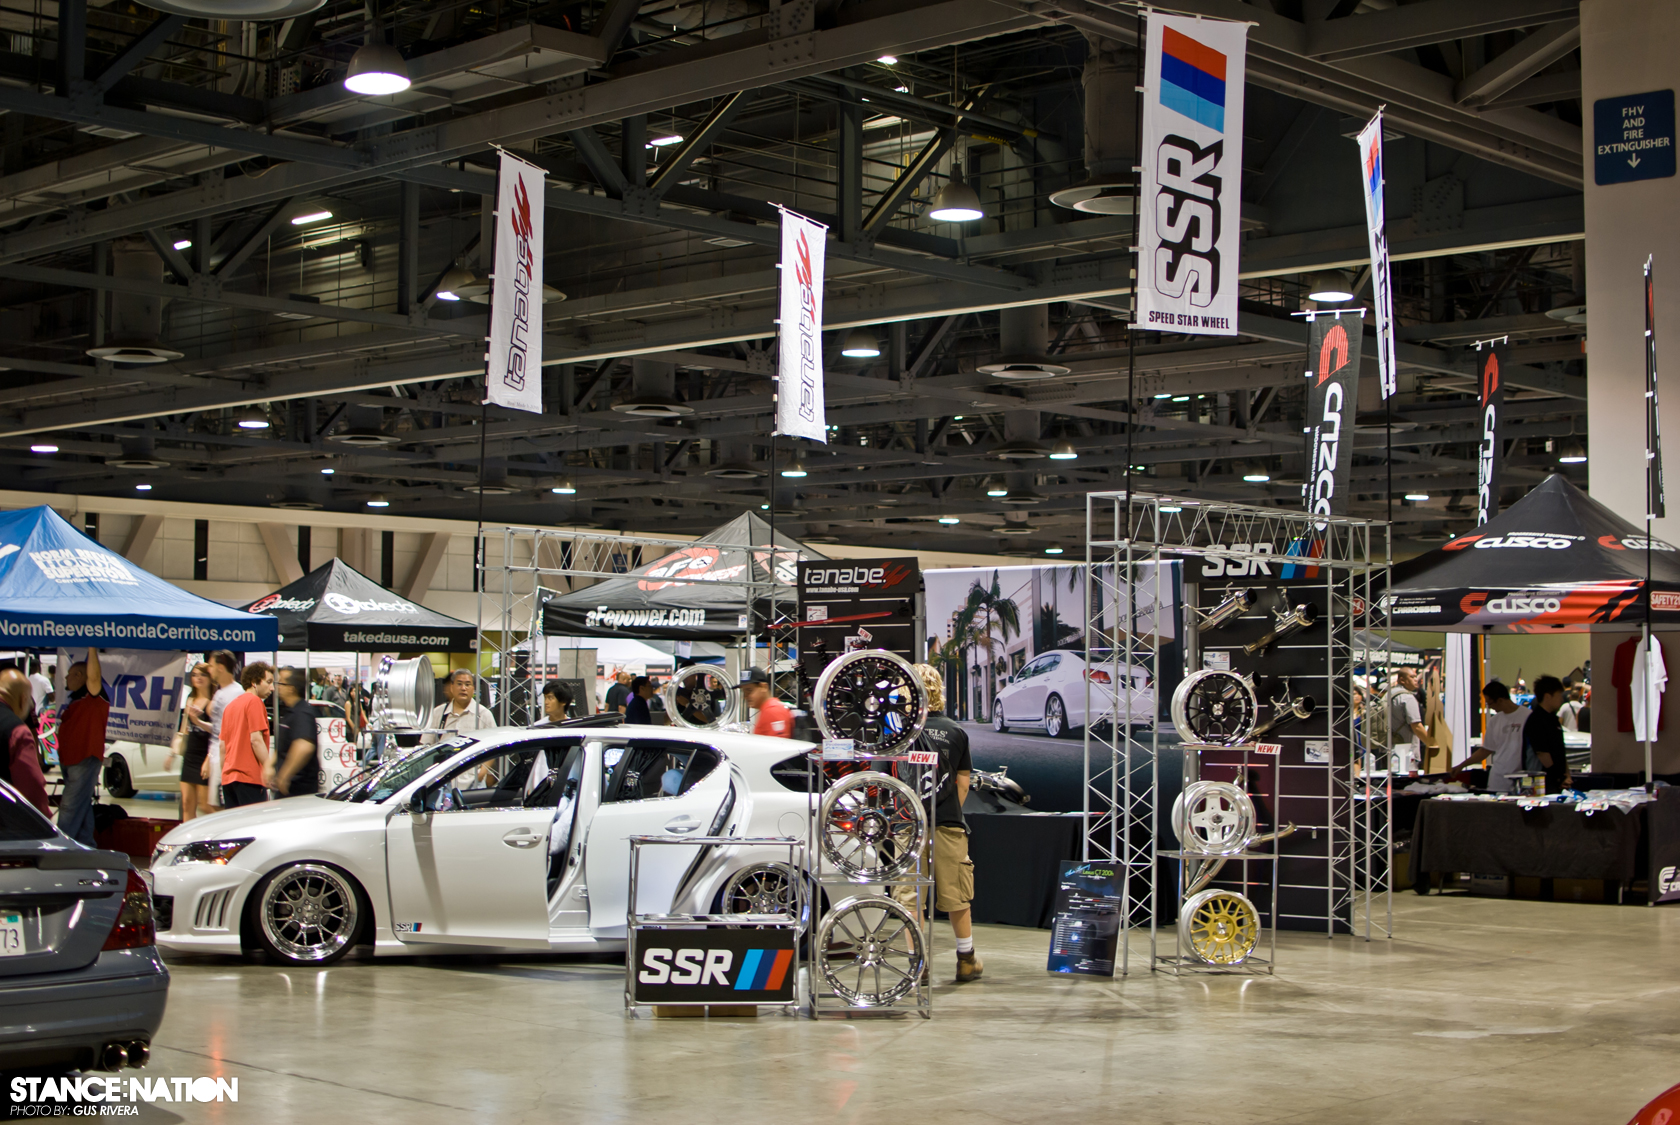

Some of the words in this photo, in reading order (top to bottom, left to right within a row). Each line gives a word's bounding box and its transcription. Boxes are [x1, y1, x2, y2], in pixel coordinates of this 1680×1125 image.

[1622, 105, 1645, 117] FHV
[1622, 117, 1646, 129] AND
[1623, 129, 1644, 140] FIRE
[1597, 137, 1670, 155] EXTINGUISHER
[1155, 134, 1224, 308] SSR
[503, 234, 531, 393] tanabe
[1148, 310, 1175, 325] SPEED
[1177, 312, 1199, 326] STAR
[1201, 315, 1230, 329] WHEEL
[799, 282, 816, 423] tanabe
[1474, 536, 1572, 549] CUSCO
[29, 549, 74, 561] NORM
[1487, 598, 1561, 614] CUSCO
[585, 605, 705, 631] aFepower.com
[0, 619, 256, 643] NormReevesHondaCerritos.com
[343, 631, 450, 645] takedausa.com
[639, 948, 733, 986] SSR
